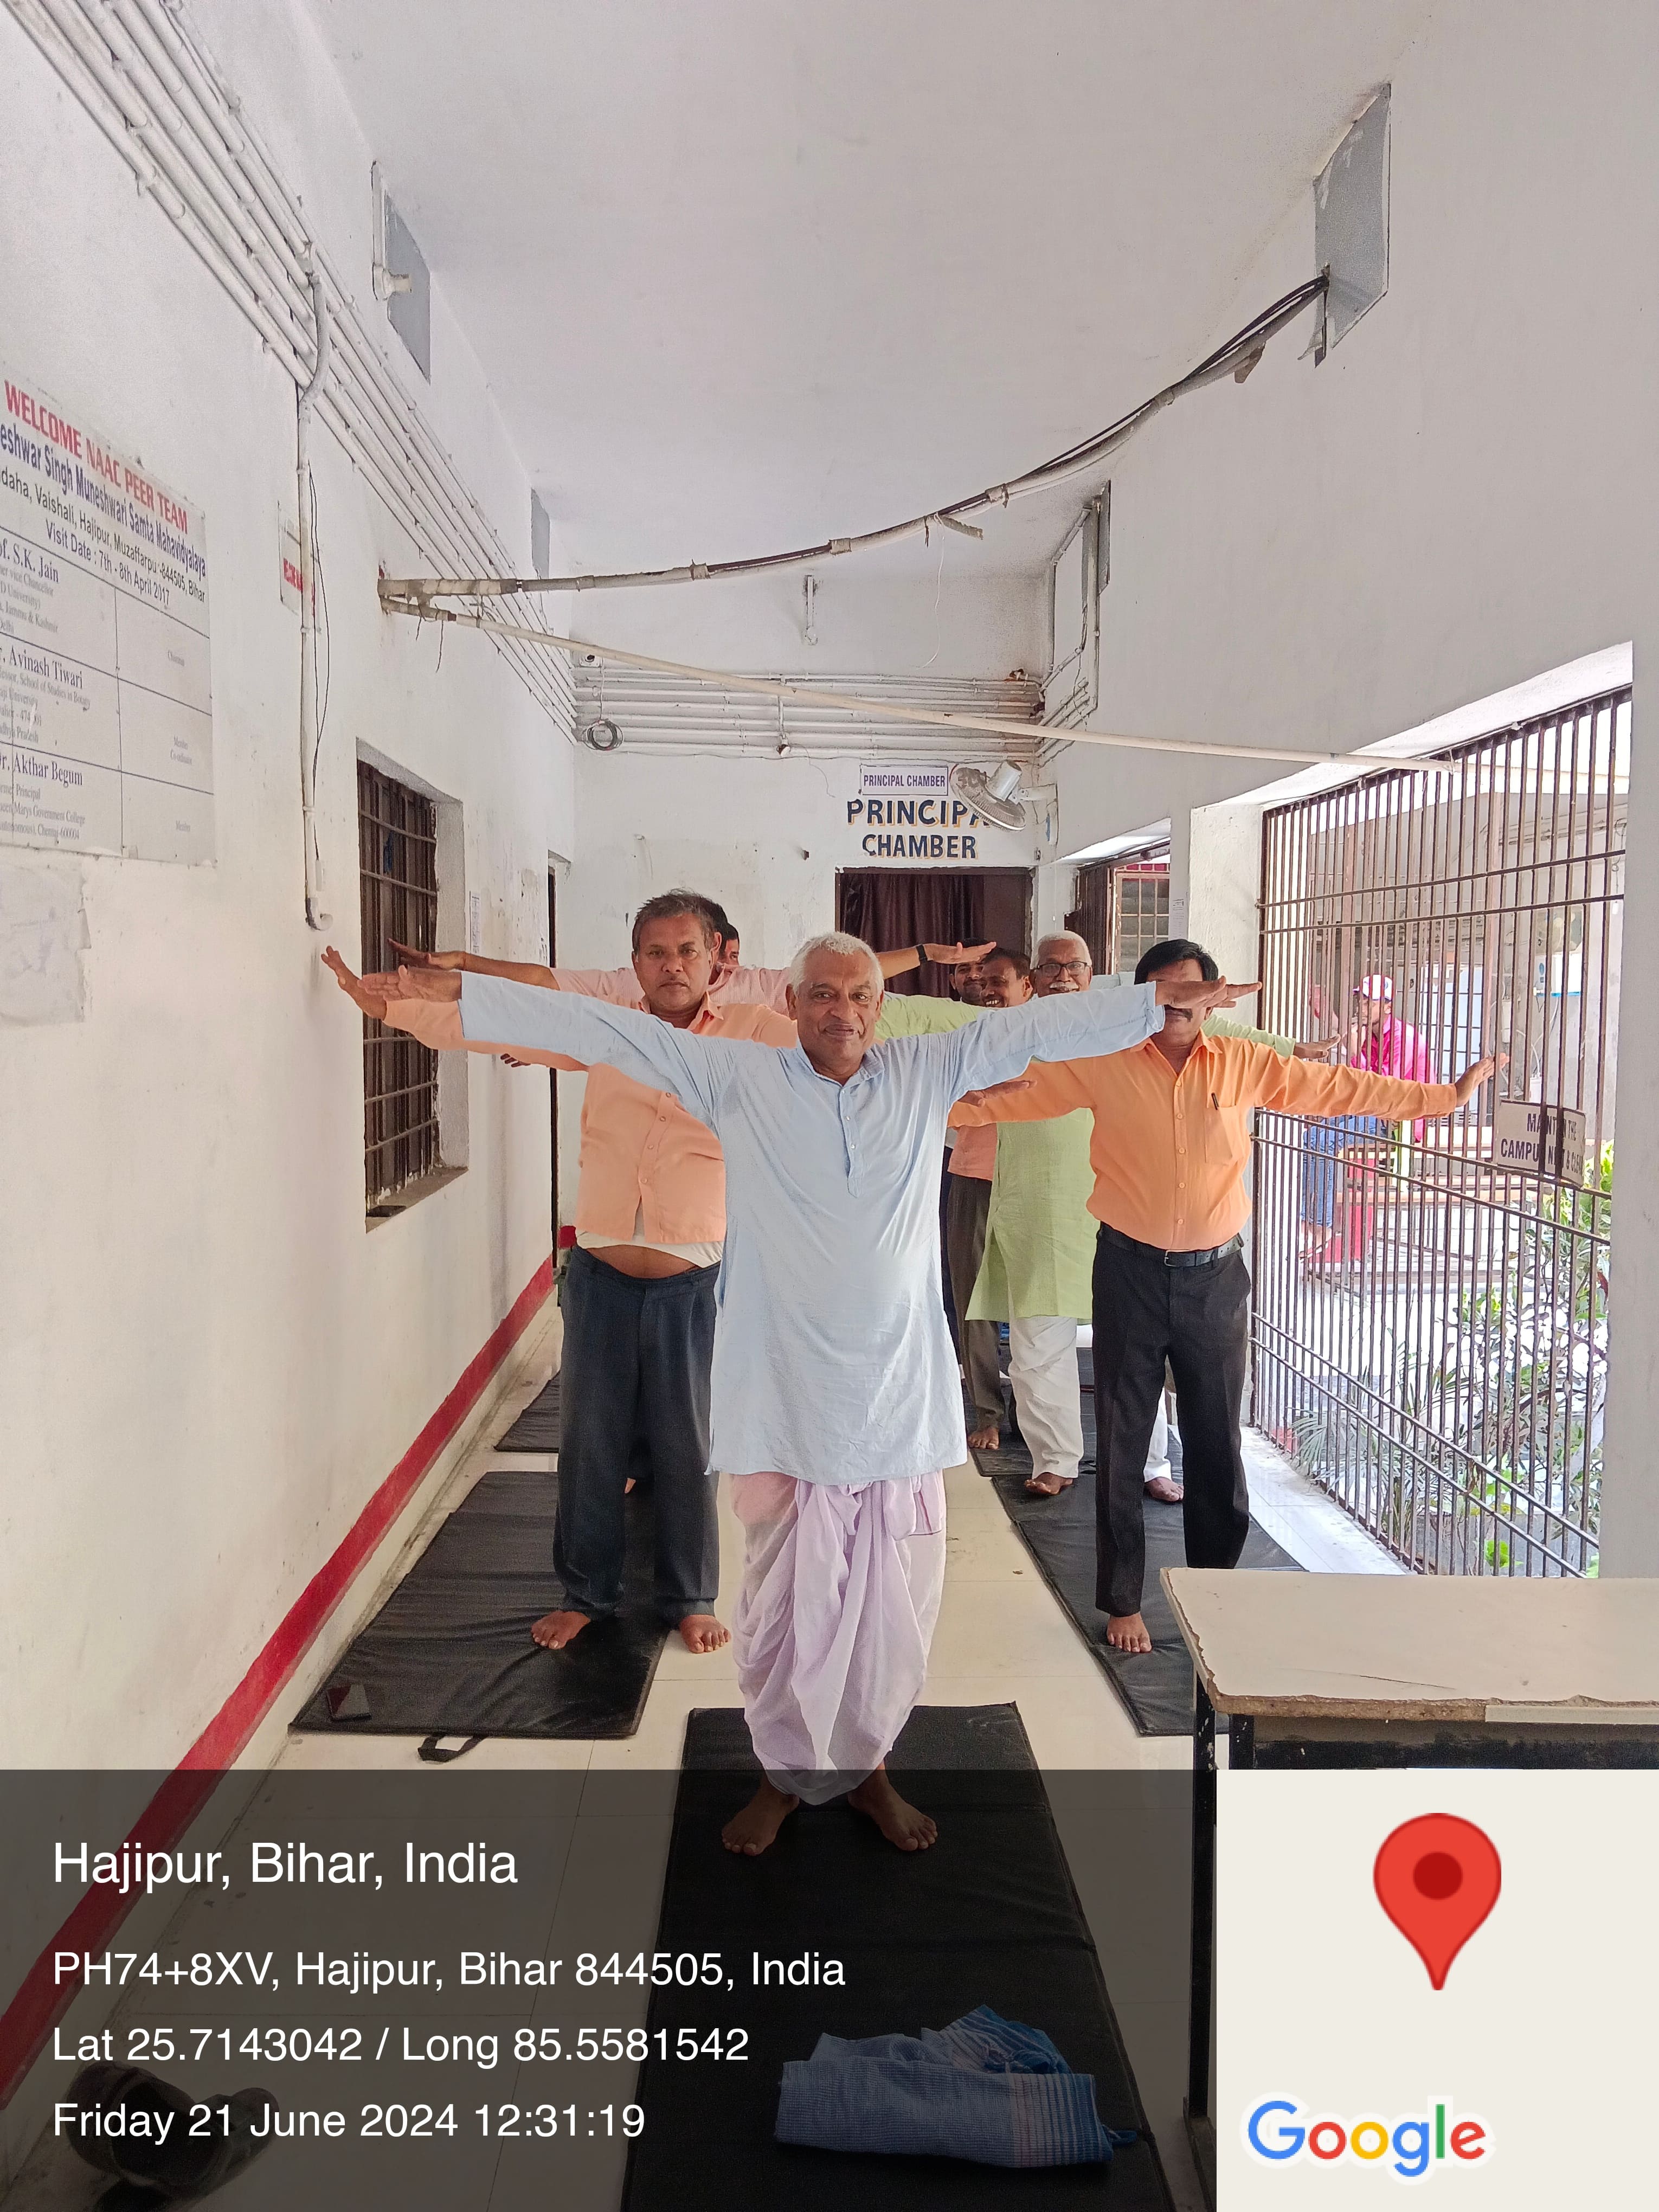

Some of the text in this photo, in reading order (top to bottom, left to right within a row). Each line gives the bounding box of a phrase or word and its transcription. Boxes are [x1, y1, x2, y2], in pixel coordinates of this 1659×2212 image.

[4, 380, 188, 535] WELCOME NAAC PEER TEAM
[45, 444, 73, 496] Singh
[75, 463, 127, 527] Muneshwari
[129, 501, 154, 544] Samta
[156, 519, 206, 582] Mahavidyalaya
[35, 484, 78, 530] Vaishali,
[80, 510, 112, 549] Hajipur,
[189, 580, 205, 603] Bihar
[46, 518, 68, 550] Visit
[71, 533, 91, 561] Date
[99, 550, 112, 574] 7th
[119, 562, 132, 587] 8th
[134, 570, 152, 595] April
[14, 543, 36, 571] S.K.
[38, 556, 59, 583] Jain
[10, 645, 49, 677] Avinash
[53, 660, 82, 690] Tiwari
[20, 672, 38, 690] School
[14, 751, 49, 780] Akthar
[52, 761, 82, 788] Begum
[864, 774, 946, 787] PRINCIPAL CHAMBER
[16, 783, 40, 802] Principal
[862, 834, 978, 859] CHAMBER
[1568, 1120, 1577, 1141] THE
